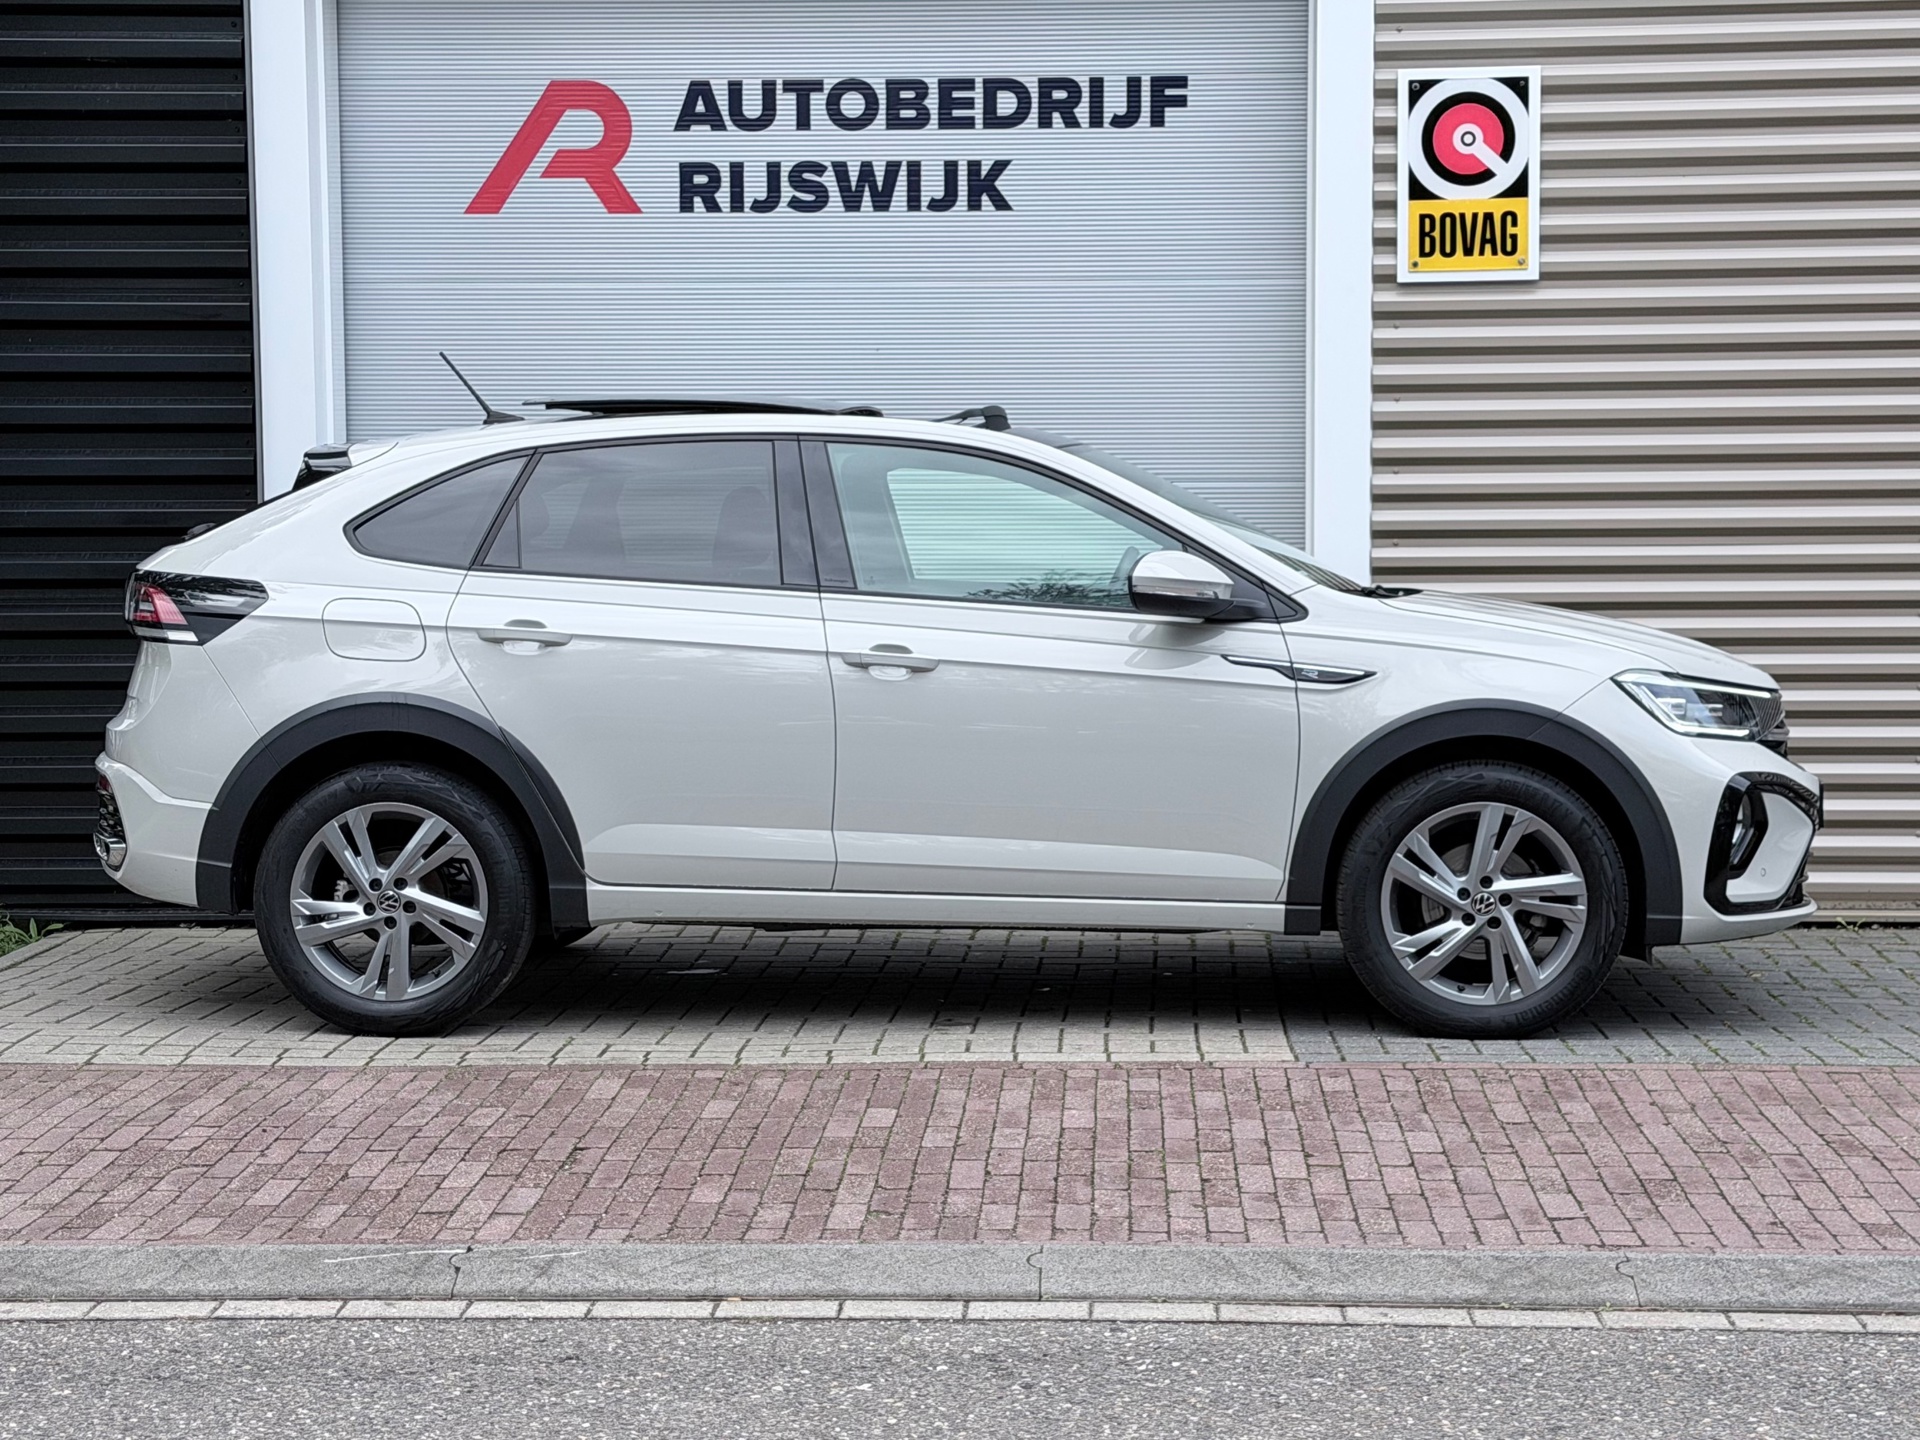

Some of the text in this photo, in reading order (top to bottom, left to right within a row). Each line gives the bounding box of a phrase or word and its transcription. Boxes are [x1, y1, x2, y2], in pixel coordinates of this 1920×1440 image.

[674, 75, 1189, 132] AUTOBEDRIJF
[679, 159, 1014, 214] RIJSWIJK
[1418, 210, 1518, 258] BOVAG
